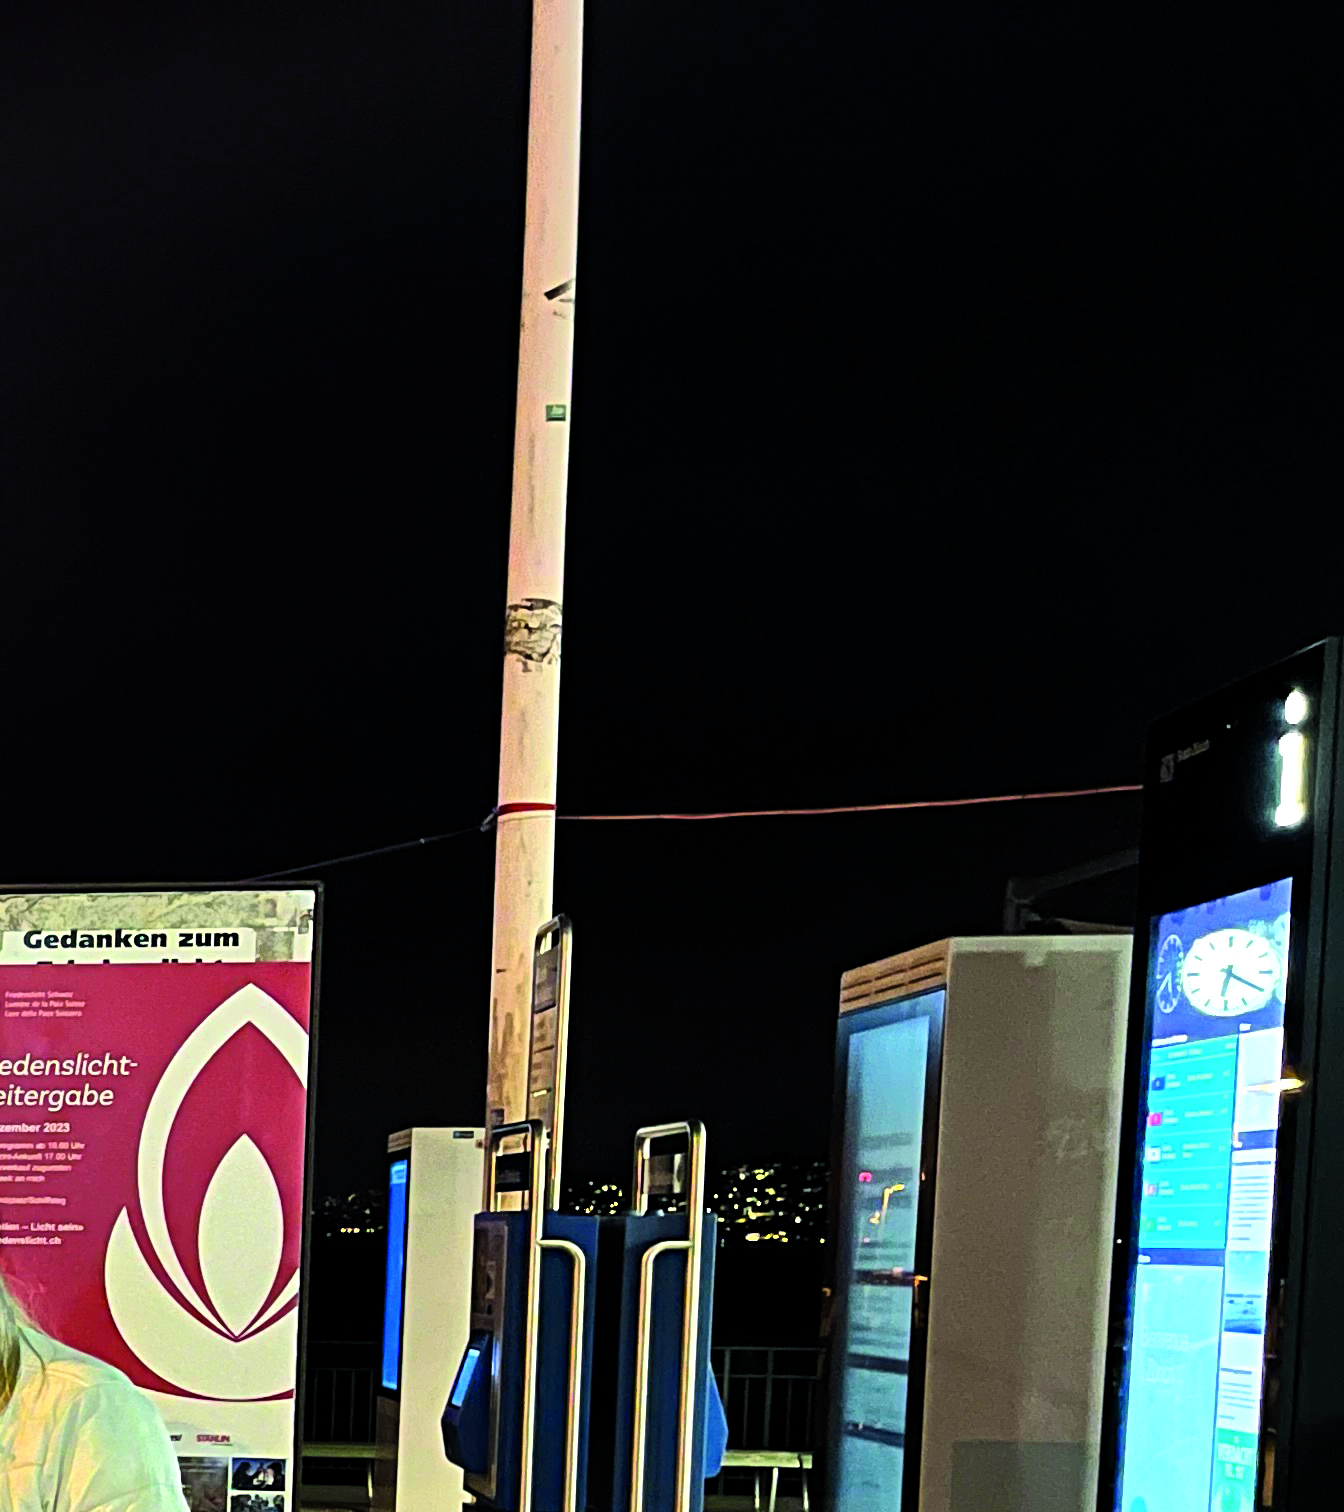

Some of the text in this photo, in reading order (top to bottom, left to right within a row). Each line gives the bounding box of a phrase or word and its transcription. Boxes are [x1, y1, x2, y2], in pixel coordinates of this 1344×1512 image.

[23, 928, 240, 949] Gedanken zum
[43, 1122, 71, 1133] 2023
[30, 1222, 56, 1232] Licht
